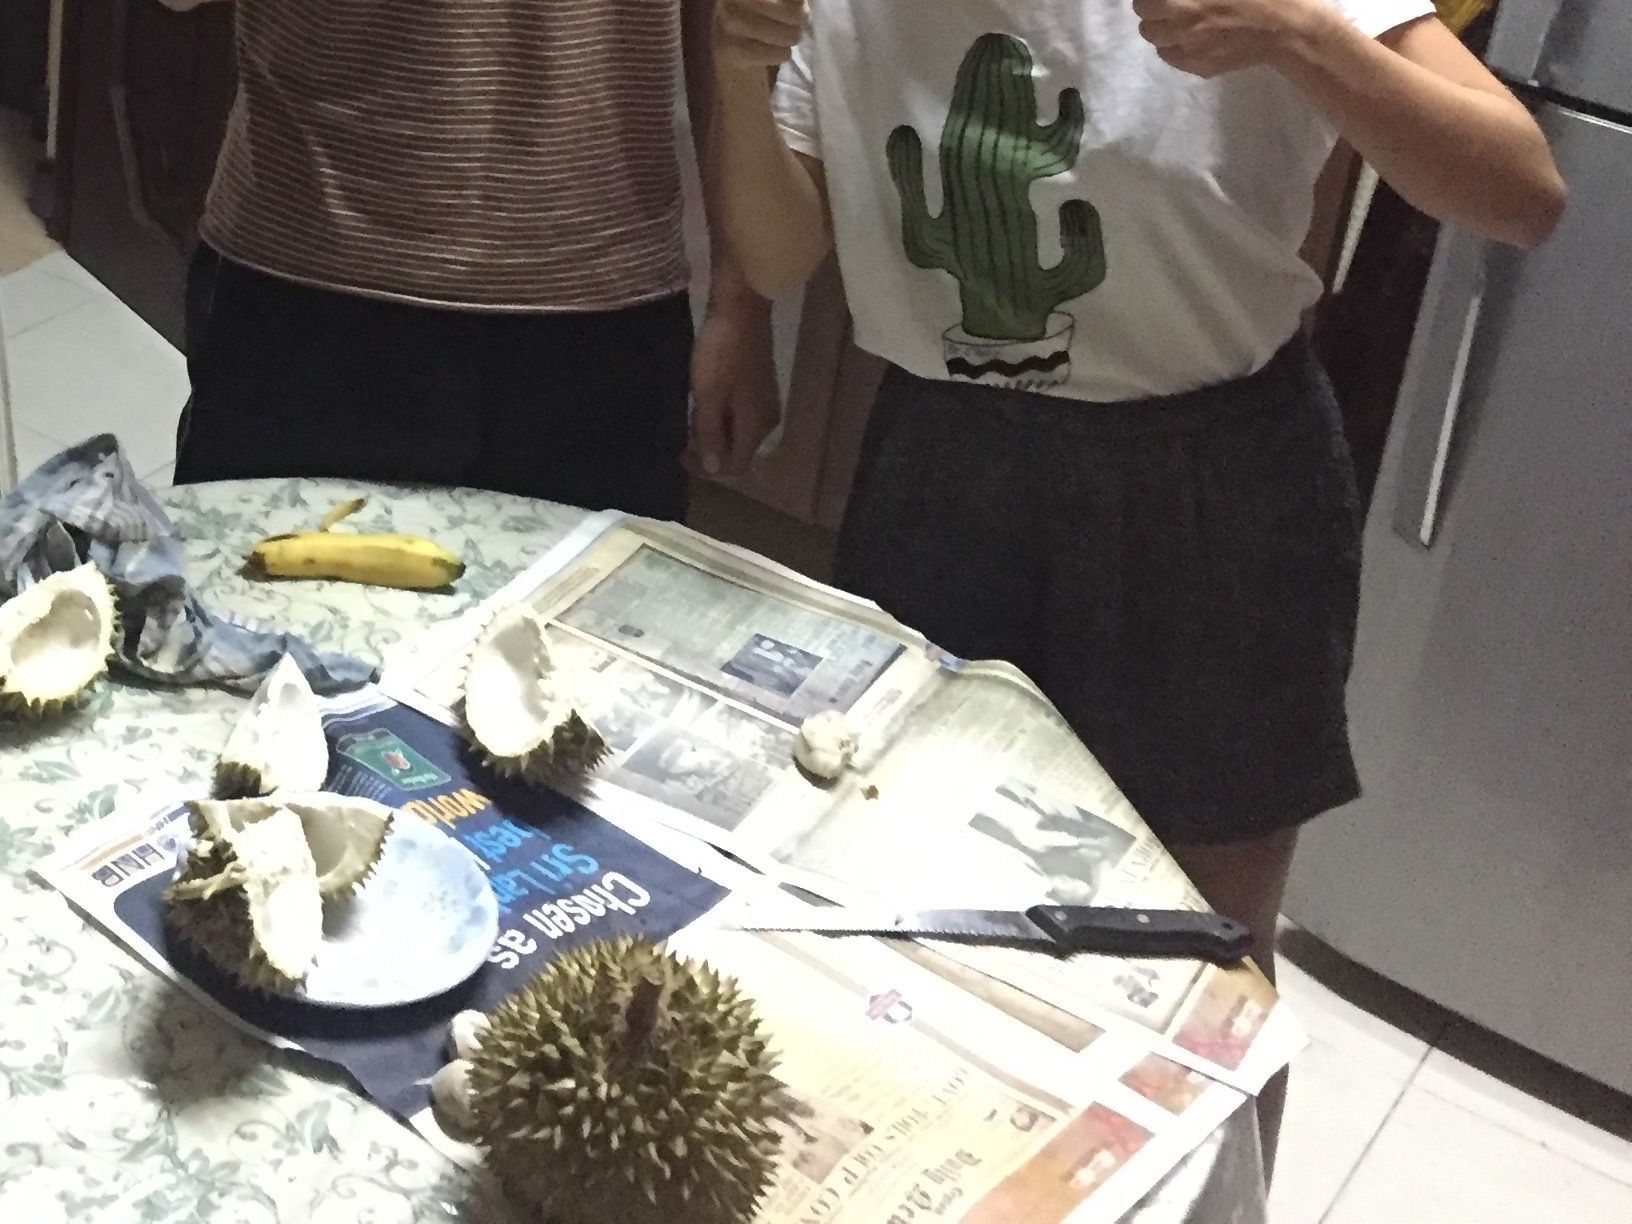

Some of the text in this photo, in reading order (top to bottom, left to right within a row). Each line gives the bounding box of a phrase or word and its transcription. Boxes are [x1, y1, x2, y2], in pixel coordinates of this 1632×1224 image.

[91, 842, 166, 888] HNB
[530, 843, 600, 888] Sri
[486, 870, 652, 970] Chosen as
